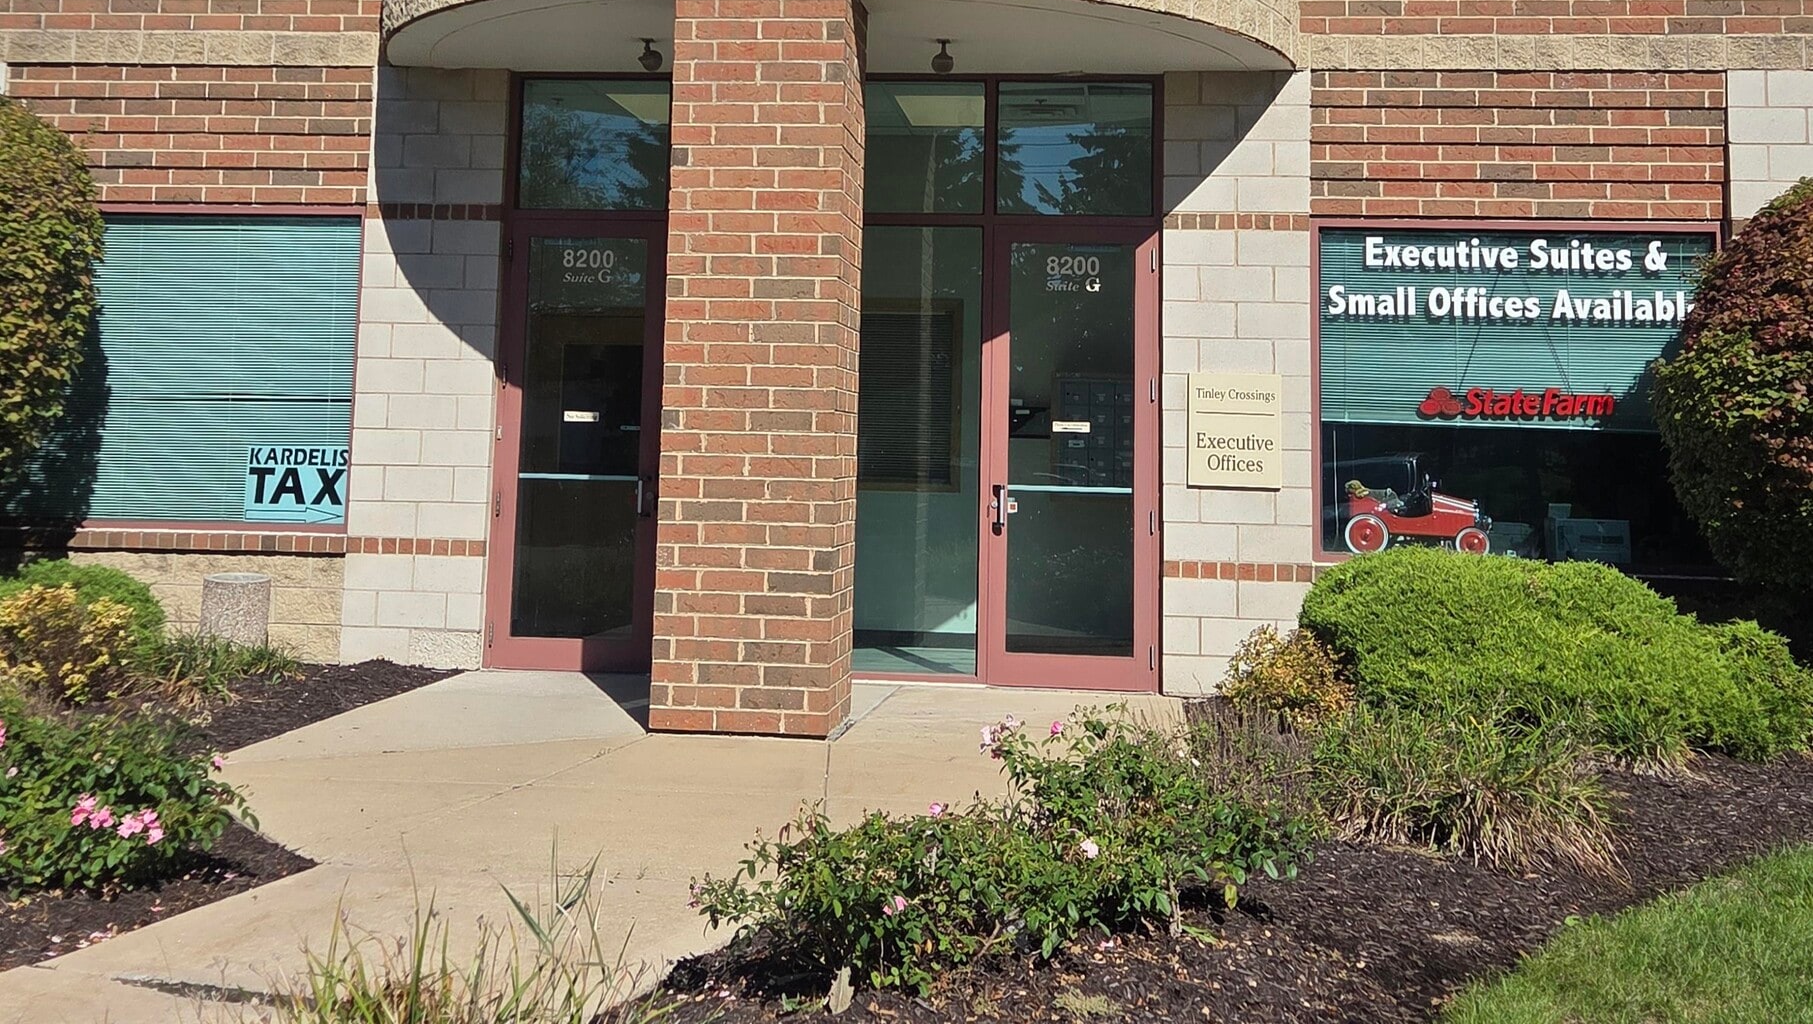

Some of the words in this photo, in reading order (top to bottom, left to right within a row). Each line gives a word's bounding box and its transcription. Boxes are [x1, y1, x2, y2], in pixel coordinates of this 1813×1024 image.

[562, 249, 614, 268] 8200
[1365, 236, 1519, 269] Executive
[1530, 238, 1633, 271] Suites
[1644, 240, 1668, 271] &
[563, 272, 596, 284] Suite
[597, 268, 612, 283] G
[1046, 256, 1100, 276] 8200
[1084, 276, 1101, 292] G
[1328, 284, 1417, 316] Small
[1428, 286, 1541, 319] Offices
[1552, 289, 1695, 322] Availabl
[1195, 387, 1226, 402] Tinley
[1228, 388, 1276, 404] Crossings
[1196, 432, 1274, 451] Executive
[249, 447, 349, 467] KARDELIS
[1207, 453, 1264, 473] Offices
[248, 466, 347, 506] TAX
